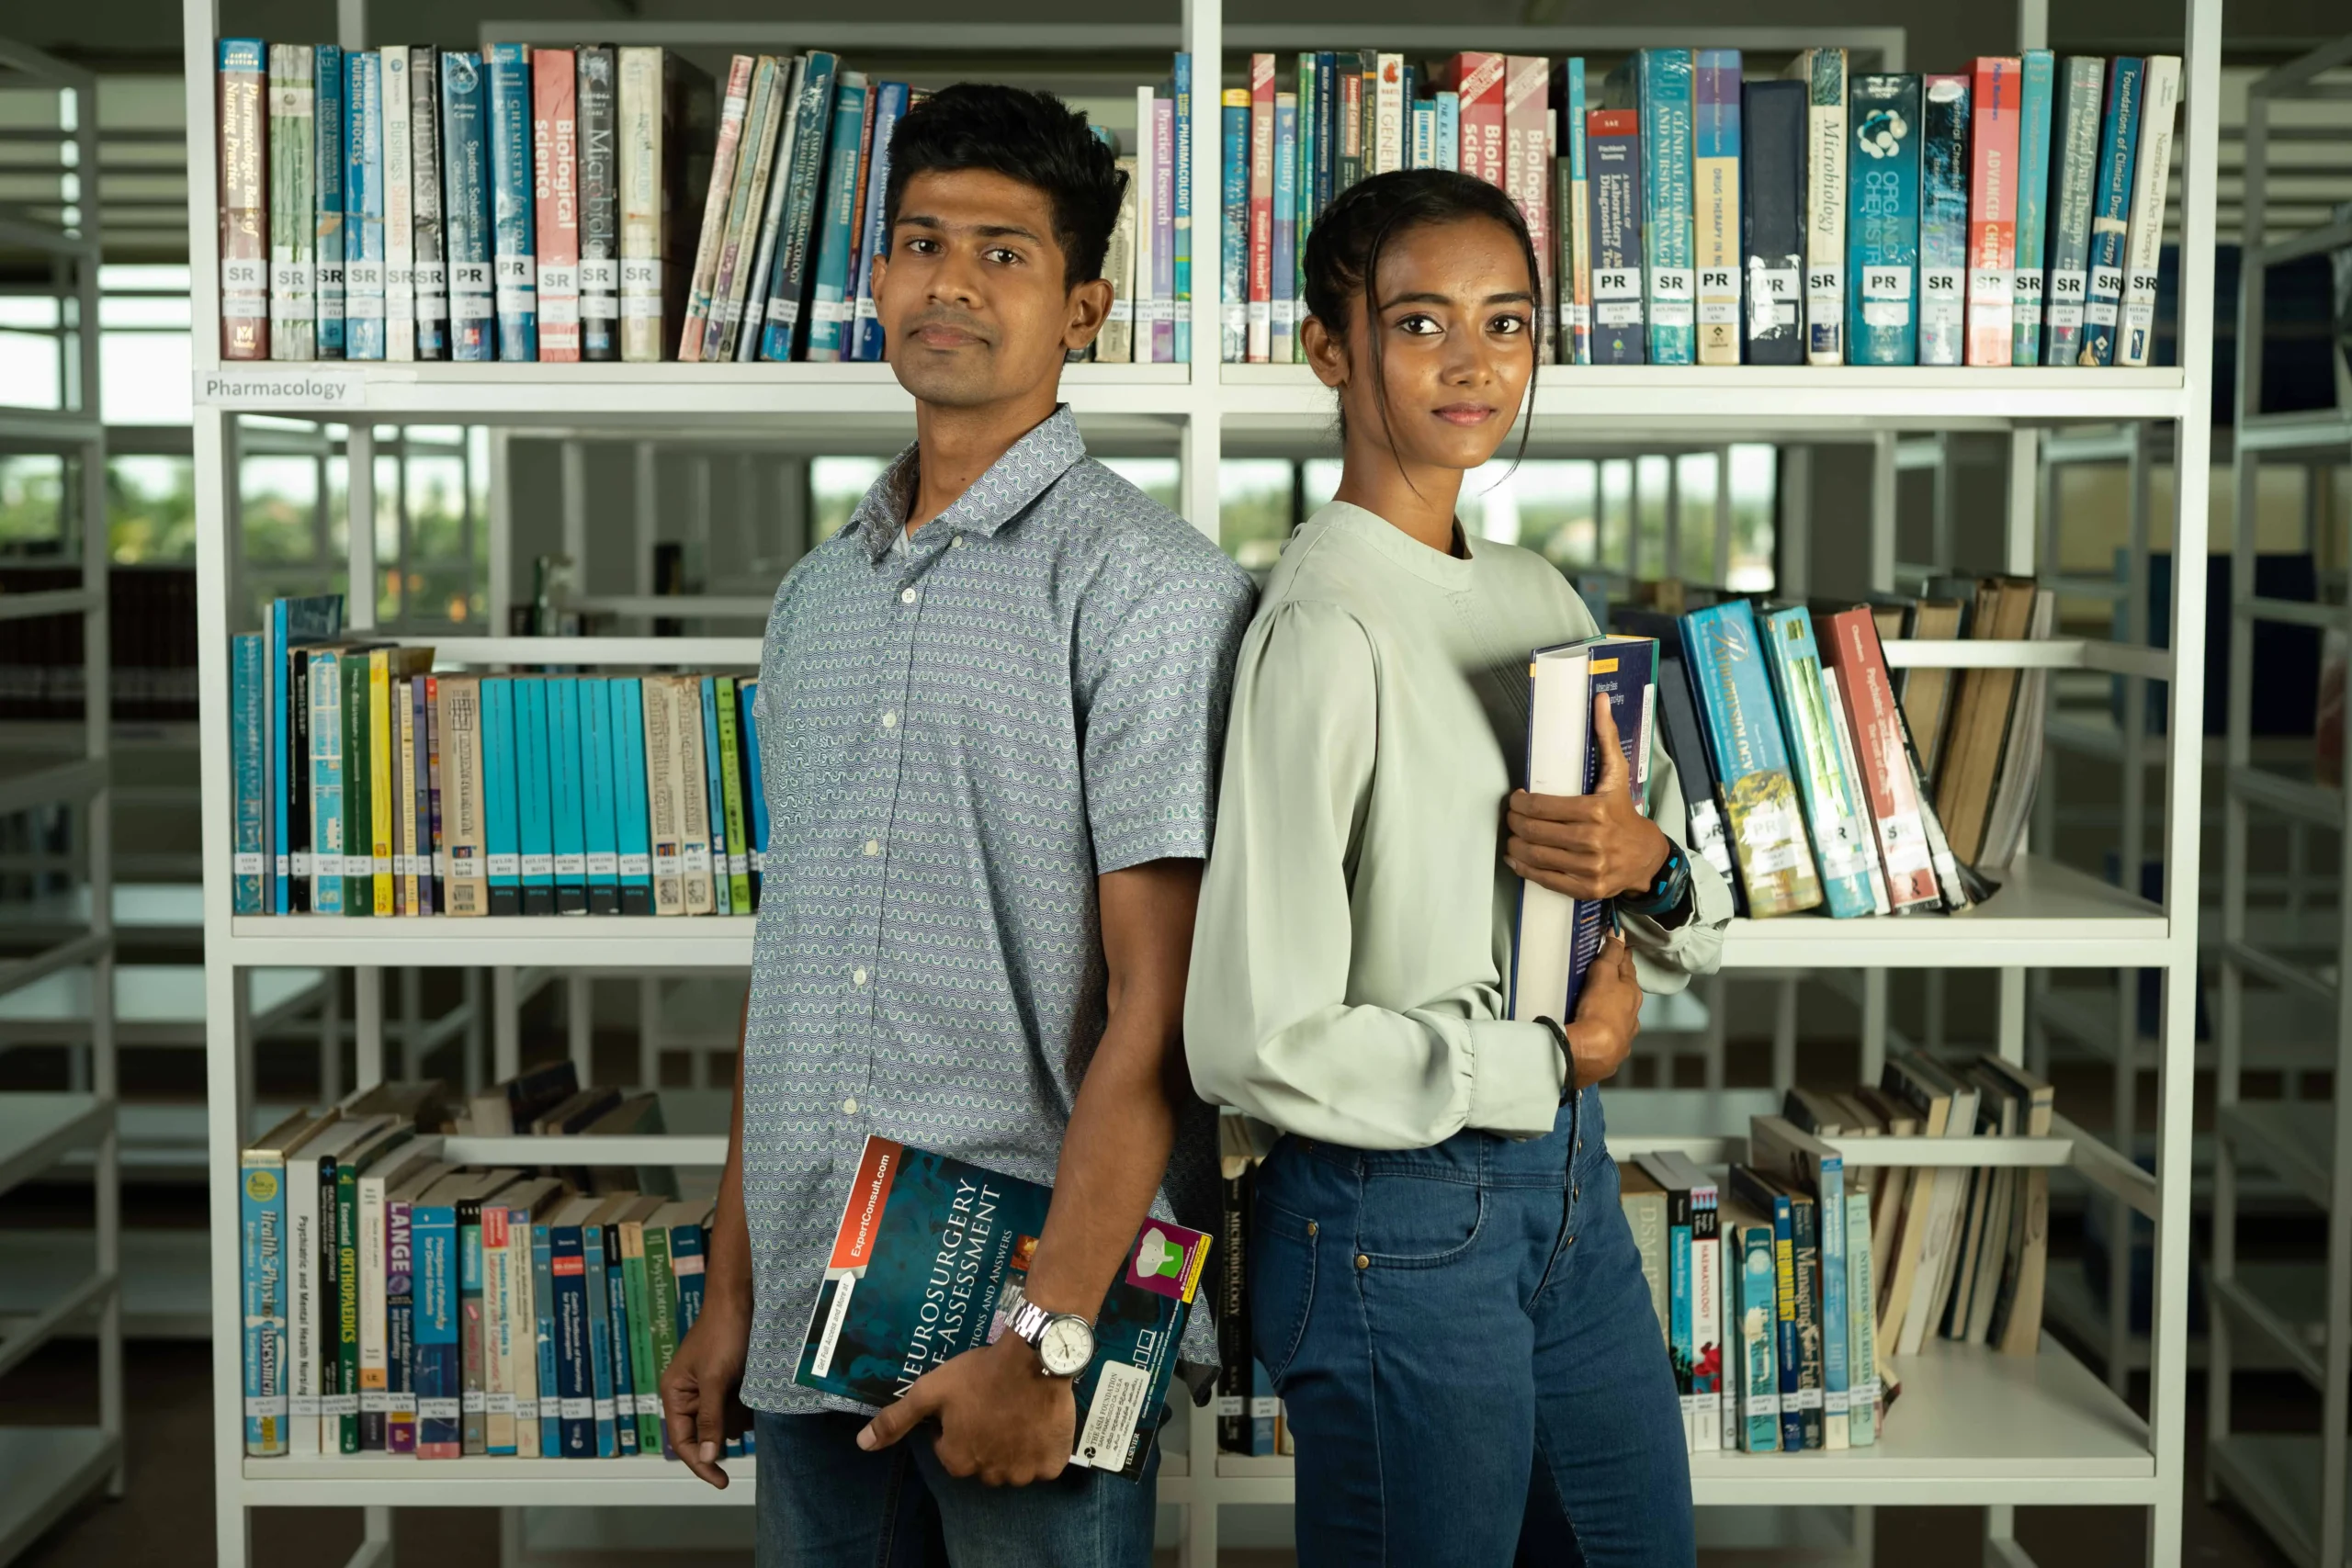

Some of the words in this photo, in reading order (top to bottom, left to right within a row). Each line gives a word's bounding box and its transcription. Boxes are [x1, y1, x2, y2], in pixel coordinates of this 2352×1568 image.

[352, 57, 362, 109] NURSING
[2118, 71, 2138, 134] Foundations
[223, 81, 239, 134] Nursing
[1658, 105, 1670, 134] AND
[241, 82, 259, 182] Pharmacologic
[352, 113, 362, 165] PROCESS
[390, 120, 406, 180] Business
[511, 99, 523, 188] CHEMISTRY
[1159, 109, 1170, 164] Practical
[1254, 116, 1272, 177] Physics
[1381, 114, 1395, 173] GENETI
[1484, 124, 1501, 183] Biolo
[1672, 111, 1684, 178] CLINICAL
[2117, 137, 2127, 149] of
[227, 138, 241, 190] Practice
[467, 140, 479, 184] Student
[535, 119, 553, 199] science
[553, 119, 576, 229] Biological
[804, 130, 821, 186] ESSENTIALS
[843, 150, 856, 188] PHYSICAL
[1178, 123, 1190, 210] PHARMACOLOGY
[1278, 134, 1294, 193] chemistry
[1658, 139, 1670, 203] NURSING
[1818, 119, 1839, 235] Microbiology
[2075, 158, 2092, 191] Drug
[2111, 152, 2126, 192] Clinical
[2152, 132, 2167, 178] Nutrition
[243, 184, 258, 219] Basis
[1158, 168, 1170, 225] Research
[1523, 129, 1544, 238] Biological
[1713, 167, 1723, 194] DRUG
[1985, 150, 2001, 220] ADVANCED
[2150, 180, 2159, 196] and
[241, 220, 258, 237] of
[391, 185, 407, 247] Statistics
[469, 186, 481, 238] Solutions
[839, 192, 852, 225] AGENTS
[1598, 175, 1611, 246] Diagnostic
[1611, 174, 1623, 248] Laboratory
[1713, 197, 1723, 238] THERAPY
[1866, 171, 1882, 265] CHEMISTR
[1883, 171, 1899, 258] ORGANIC
[2070, 195, 2089, 247] Therapy
[2148, 197, 2160, 219] Diet
[789, 200, 812, 284] PHARMACOLOGY
[1658, 206, 1670, 266] MANAGE
[1713, 241, 1723, 253] IN
[2142, 221, 2157, 263] Therapy
[229, 267, 254, 281] SR
[278, 271, 304, 285] SR
[317, 269, 343, 283] SR
[351, 269, 377, 283] SR
[388, 270, 413, 285] SR
[416, 270, 443, 285] SR
[457, 269, 482, 282] PR
[500, 262, 525, 276] PR
[544, 274, 570, 288] SR
[583, 268, 609, 282] SR
[625, 267, 651, 281] SR
[1256, 254, 1267, 289] Herbert
[1601, 276, 1626, 288] PR
[1659, 276, 1683, 289] SR
[1703, 274, 1728, 287] PR
[1811, 275, 1836, 288] SR
[1871, 276, 1896, 288] PR
[1928, 276, 1953, 289] SR
[2017, 277, 2041, 289] SR
[2057, 278, 2080, 292] SR
[2098, 276, 2121, 290] SR
[2133, 276, 2157, 290] SR
[207, 379, 346, 400] Pharmacology
[1866, 668, 1883, 718] Psychiatric
[341, 1201, 352, 1246] Essential
[851, 1154, 889, 1258] ExpertConsult.com
[261, 1211, 277, 1256] Health
[297, 1215, 309, 1269] Psychiatric
[390, 1202, 410, 1272] LANGE
[300, 1272, 308, 1289] and
[930, 1185, 1001, 1371] F-ASSESSMENT
[981, 1284, 996, 1312] AND
[989, 1229, 1012, 1283] ANSWERS
[1230, 1212, 1240, 1315] MICROBIOLOGY
[1701, 1245, 1710, 1318] HAEMATOLOGY
[299, 1292, 308, 1325] Mental
[341, 1248, 356, 1343] ORTHOPAEDICS
[650, 1254, 671, 1339] Psychotropic
[892, 1178, 977, 1398] NEUROSURGERY
[1794, 1247, 1816, 1328] Managing
[1860, 1250, 1871, 1337] INTERPERSONAL
[299, 1328, 309, 1358] Health
[571, 1316, 580, 1348] Textbook
[820, 1346, 829, 1359] Full
[825, 1323, 836, 1345] Access
[836, 1292, 845, 1307] More
[842, 1283, 849, 1292] at
[572, 1348, 581, 1357] of
[574, 1357, 582, 1393] Neurology
[297, 1361, 309, 1396] Nursing
[1096, 1417, 1104, 1433] ASIA
[1100, 1372, 1117, 1416] FOUNDATION
[1102, 1404, 1114, 1435] FRANCISCO
[1125, 1433, 1140, 1465] ELSEVIER
